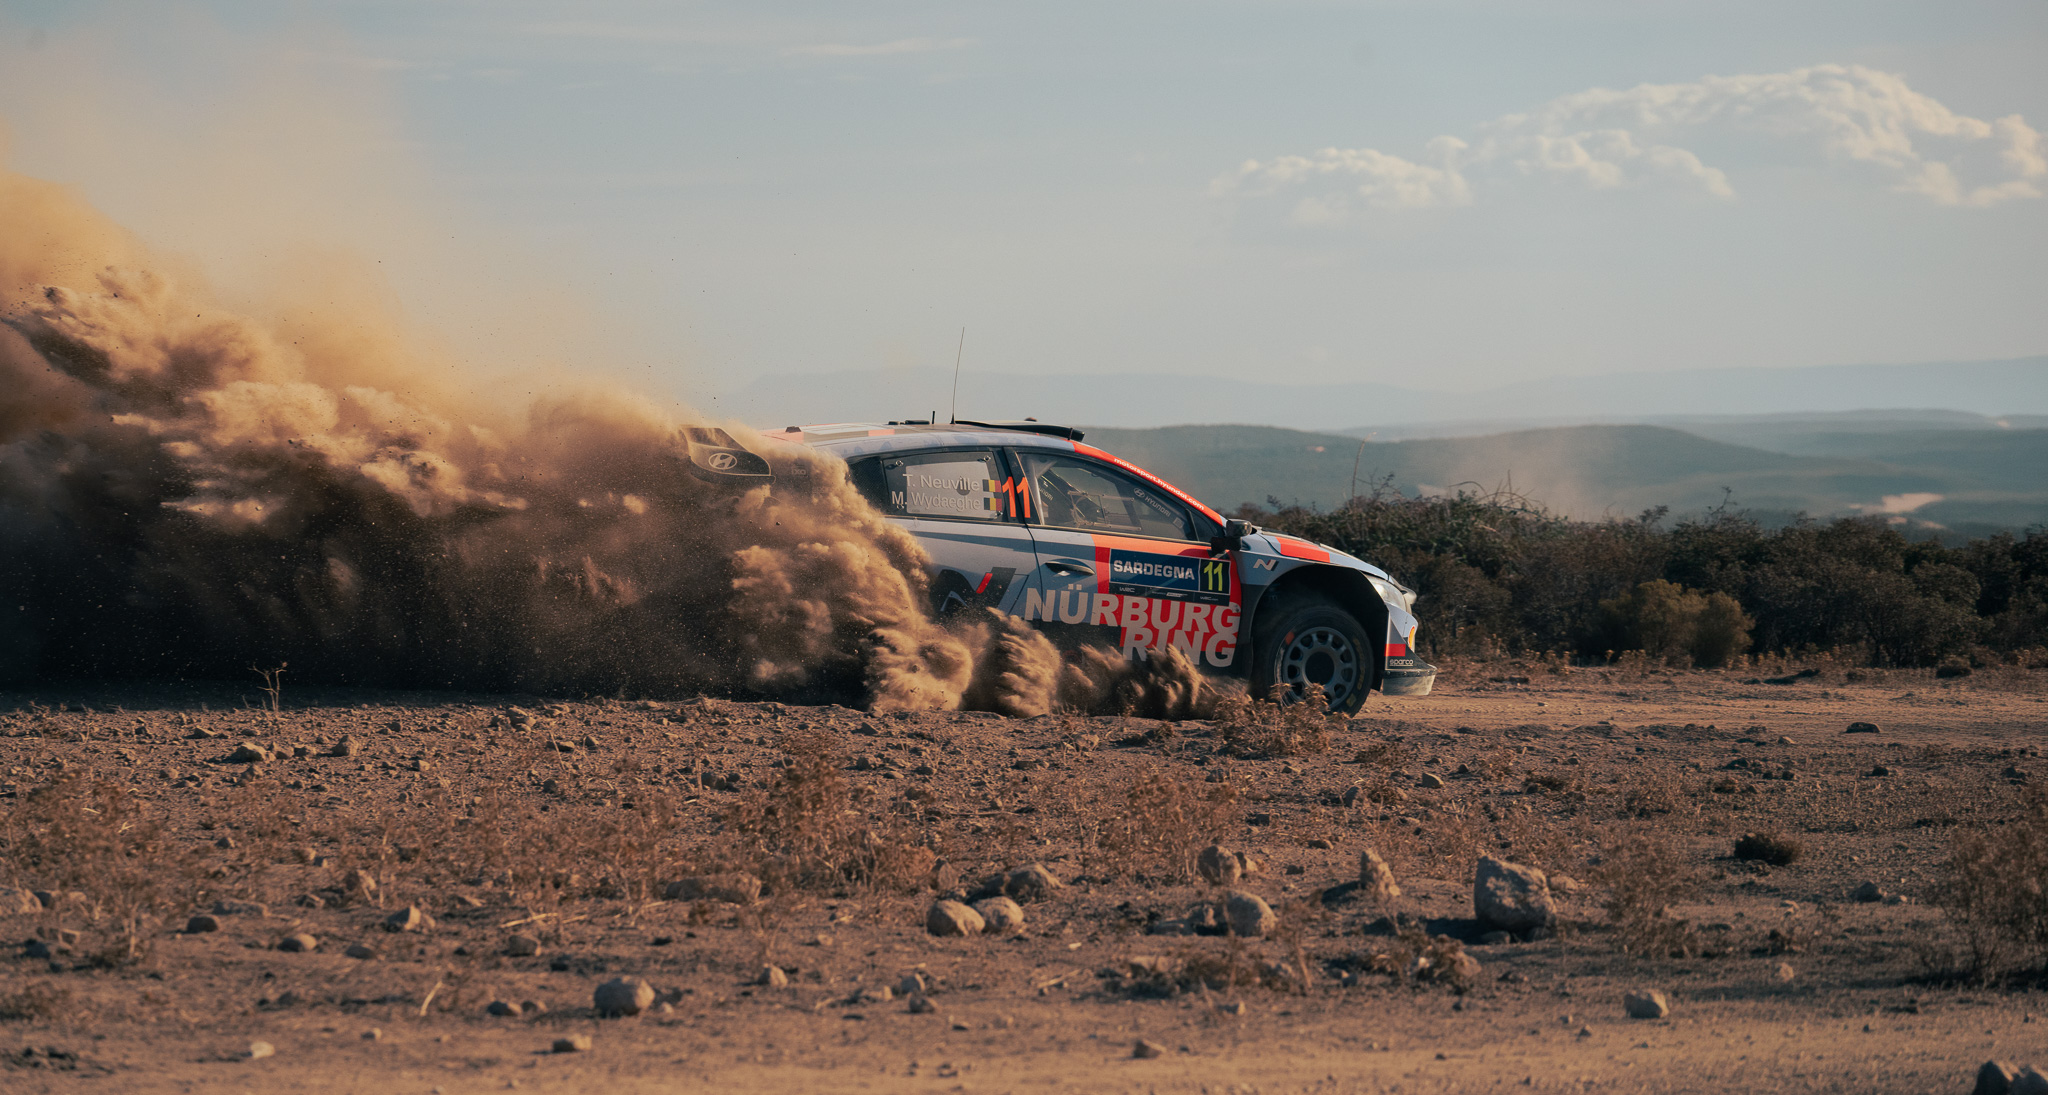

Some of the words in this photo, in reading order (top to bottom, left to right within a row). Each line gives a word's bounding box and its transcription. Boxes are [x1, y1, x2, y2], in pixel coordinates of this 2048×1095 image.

[902, 473, 916, 487] T.
[920, 475, 981, 491] Neuville
[1114, 457, 1205, 511] motorsport.hyundai.com
[891, 491, 907, 505] M.
[911, 492, 981, 512] Wydaeghe
[1002, 476, 1031, 518] 11
[1144, 496, 1171, 517] HYUNDAI
[1113, 559, 1195, 581] SARDEGNA
[1203, 561, 1223, 591] 11
[1024, 584, 1241, 634] NÜRBURG
[1389, 659, 1414, 667] sparco
